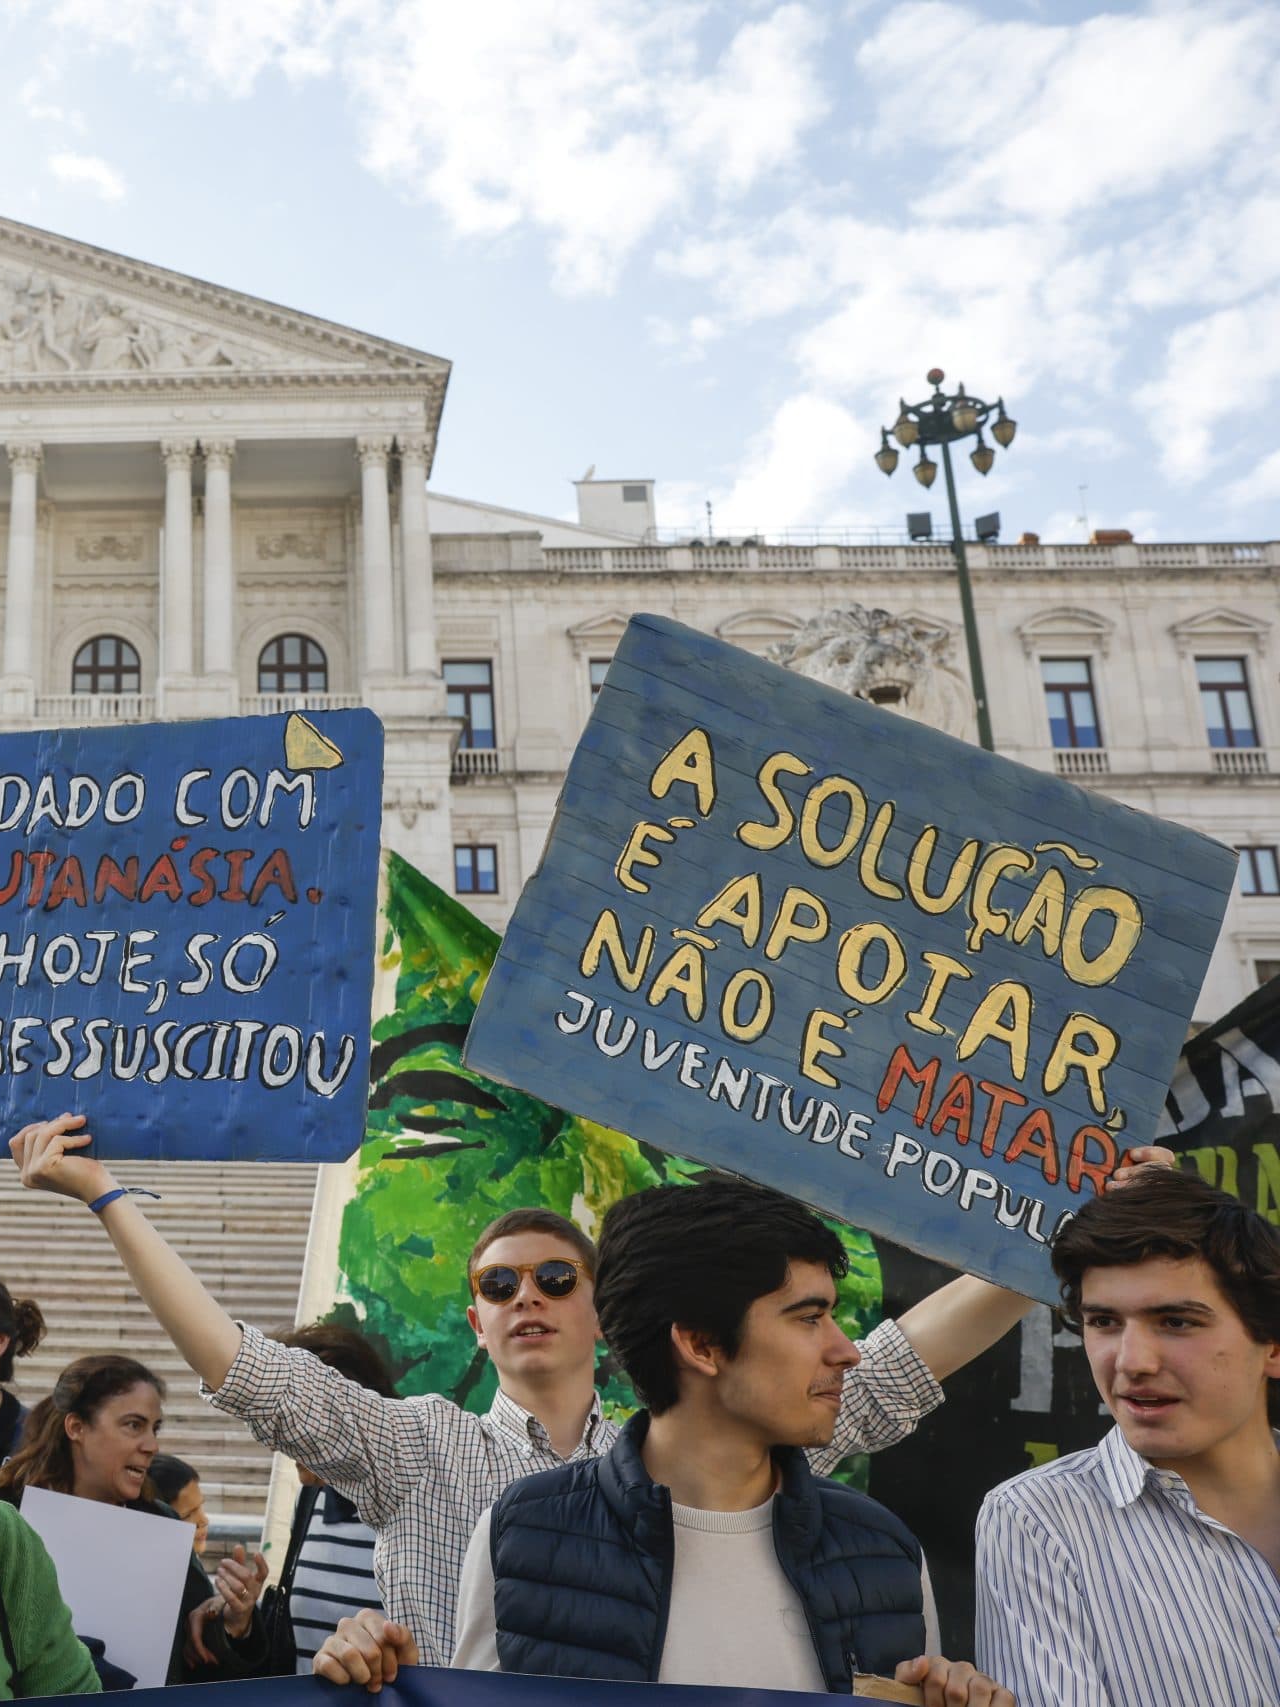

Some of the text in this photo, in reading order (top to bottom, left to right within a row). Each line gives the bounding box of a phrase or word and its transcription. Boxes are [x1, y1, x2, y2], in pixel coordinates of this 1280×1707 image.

[175, 768, 317, 831] COM
[615, 817, 696, 894] É
[649, 726, 1145, 987] A SOLUÇÃO
[555, 990, 874, 1159] JUVENTUDE
[578, 908, 775, 1045] NÃO
[798, 1008, 860, 1088] É
[876, 1044, 1134, 1196] MATAR
